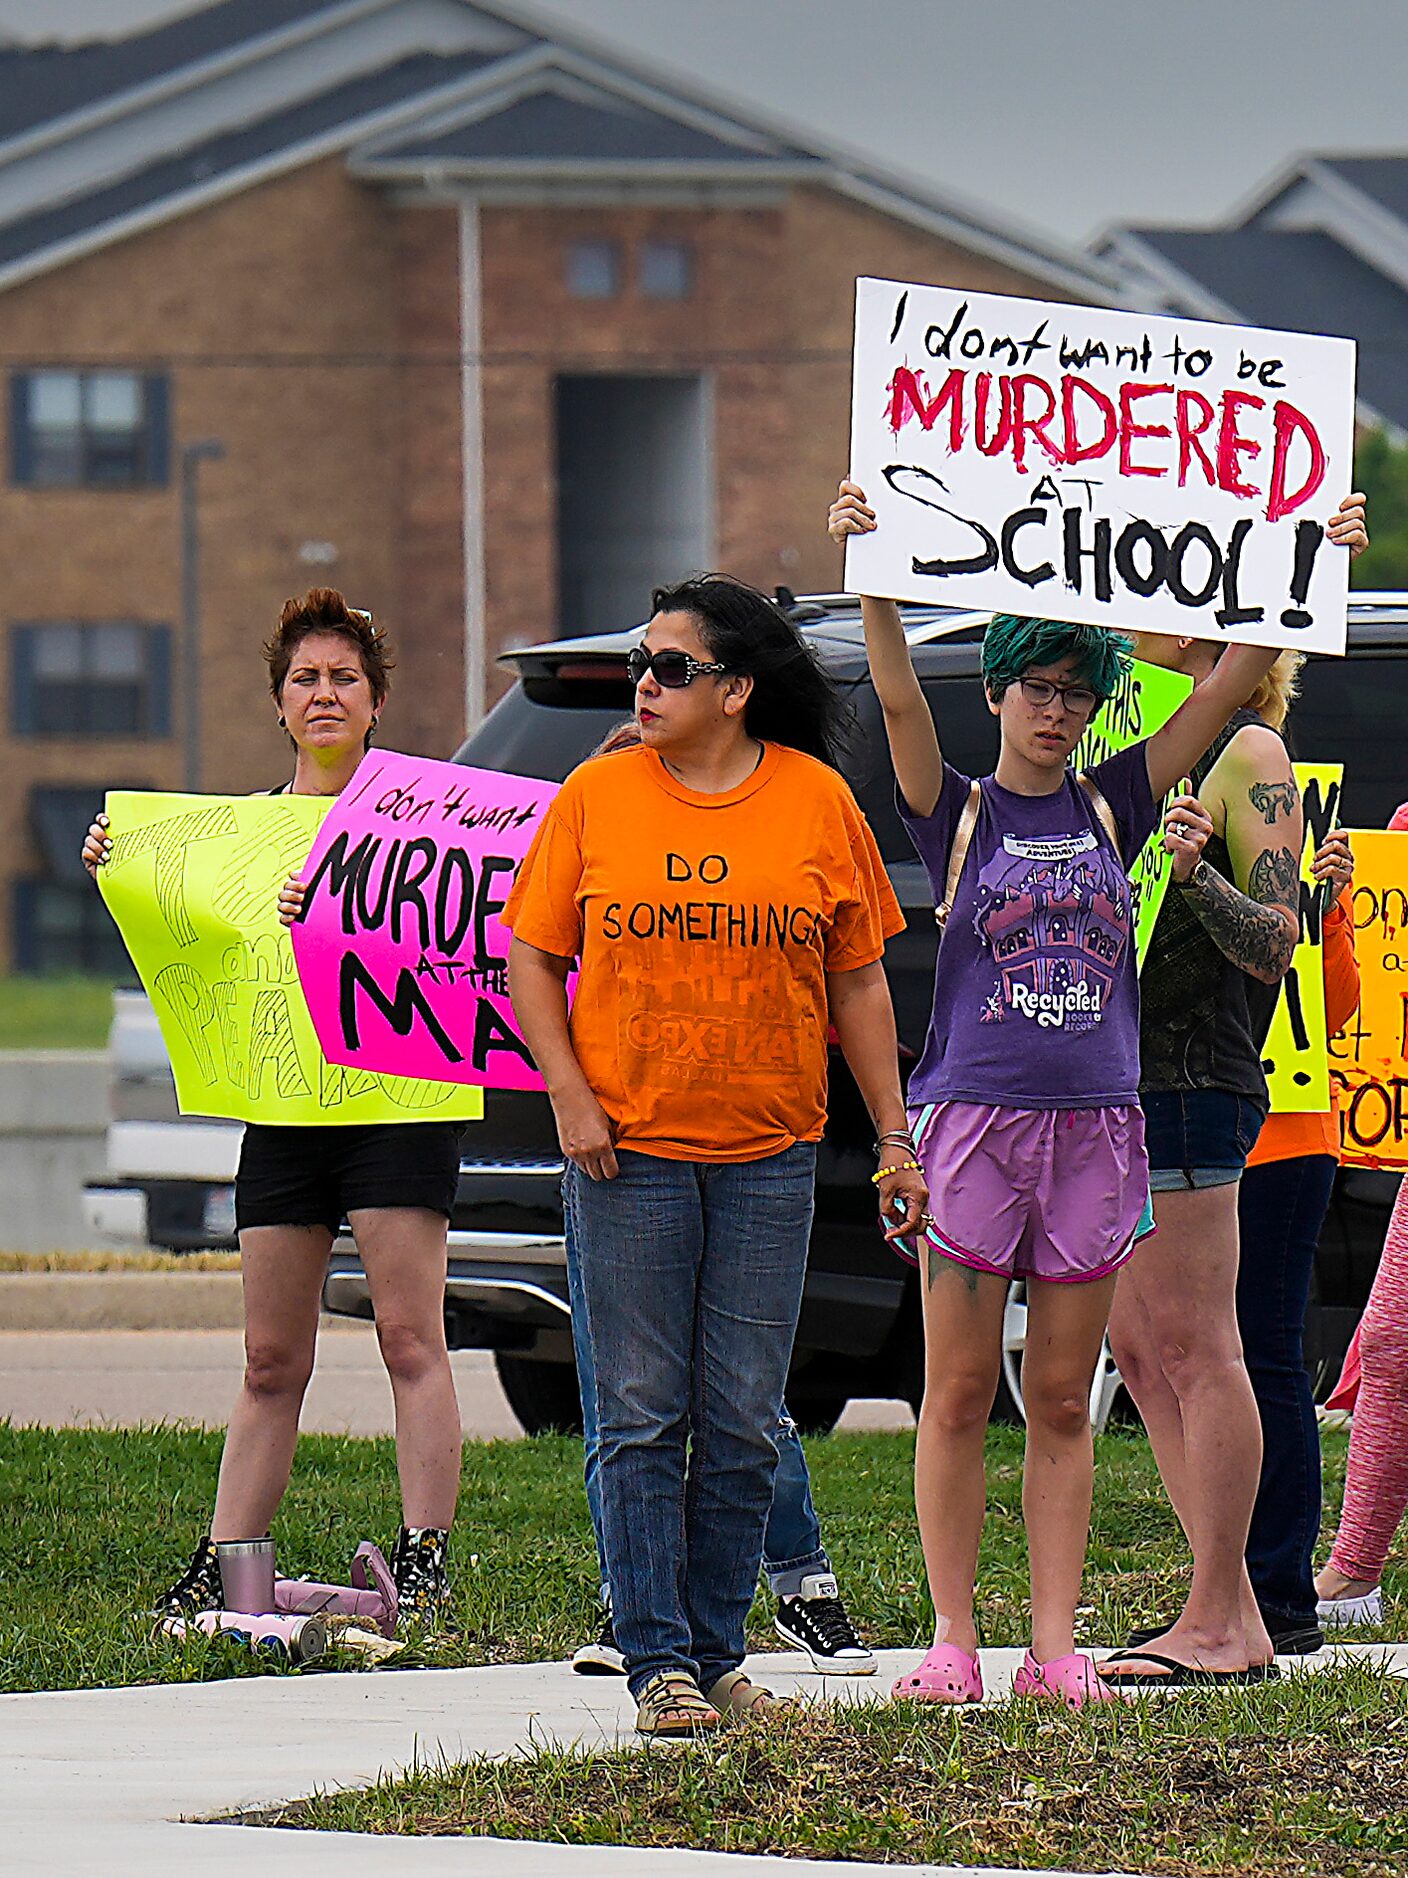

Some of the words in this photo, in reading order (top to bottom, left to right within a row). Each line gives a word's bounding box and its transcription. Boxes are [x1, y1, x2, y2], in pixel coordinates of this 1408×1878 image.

[888, 289, 908, 343] I
[1162, 334, 1212, 377] to
[1236, 349, 1286, 388] be
[883, 357, 1328, 522] MURDERED
[1030, 475, 1104, 512] AT
[348, 767, 384, 807] I
[375, 777, 464, 825] don't
[666, 853, 729, 884] DO
[295, 830, 523, 975] MURDE
[416, 953, 465, 987] AT
[461, 960, 510, 998] THE
[1012, 980, 1100, 1027] Recycled
[340, 950, 541, 1073] MA
[1327, 1000, 1372, 1063] et
